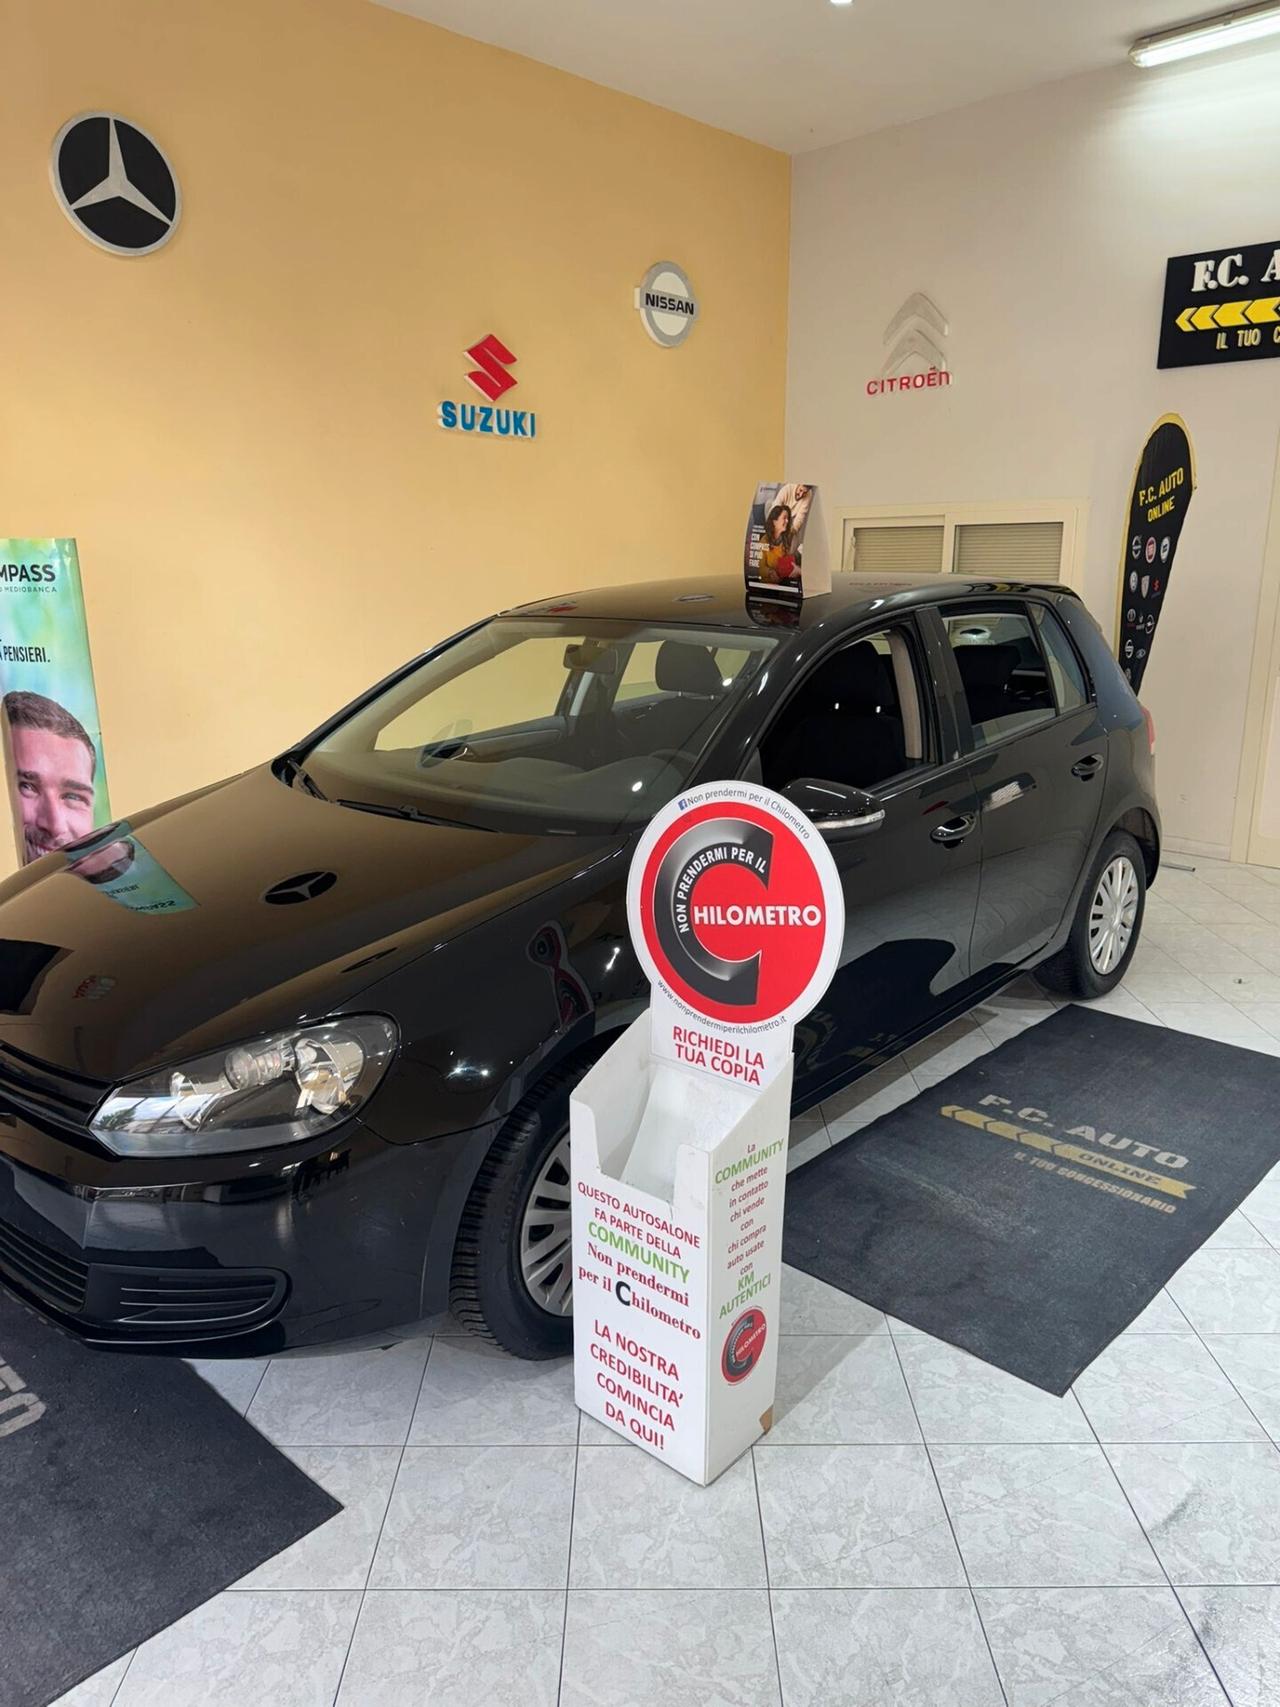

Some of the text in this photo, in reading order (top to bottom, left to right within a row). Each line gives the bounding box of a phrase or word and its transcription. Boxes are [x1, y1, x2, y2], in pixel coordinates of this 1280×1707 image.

[1191, 253, 1250, 292] F.C.
[645, 292, 695, 316] NISSAN
[1216, 332, 1229, 350] IL
[1237, 328, 1261, 347] TUO
[440, 400, 536, 438] SUZUKI
[1138, 467, 1185, 506] F.C. AUTO
[1147, 495, 1176, 522] ONLINE
[3, 646, 50, 662] PENSIERI.
[687, 795, 704, 806] Non
[705, 788, 747, 801] prendermi
[749, 792, 763, 803] per
[770, 801, 810, 840] Chilometro
[676, 847, 766, 933] NON PRENDERMI PER IL
[657, 980, 787, 1034] www.nonprendermiperilchilometro.it
[673, 1026, 764, 1069] RICHIEDI LA
[675, 1043, 760, 1086] TUA COPIA
[747, 1144, 756, 1154] La
[978, 1094, 1189, 1169] F.C. AUTO
[715, 1138, 784, 1185] COMMUNITY
[731, 1167, 768, 1192] che mette
[1078, 1153, 1162, 1185] ONLINE
[729, 1181, 769, 1208] in contatto
[1029, 1156, 1055, 1172] TUO
[1056, 1167, 1177, 1215] CONCESSIONARIO
[577, 1182, 700, 1248] QUESTO AUTOSALONE
[730, 1196, 765, 1222] chi vende
[740, 1218, 754, 1231] con
[588, 1221, 690, 1283] COMMUNITY
[594, 1207, 681, 1259] FA PARTE DELLA
[728, 1225, 767, 1254] chi compra
[587, 1241, 689, 1307] Non prendermi
[727, 1240, 765, 1270] auto usate
[740, 1262, 753, 1275] con
[719, 1272, 771, 1319] AUTENTICI
[737, 1270, 754, 1291] KM
[578, 1266, 701, 1340] per il Chilometro
[595, 1319, 679, 1381] LA NOSTRA
[597, 1372, 675, 1431] COMINCIA
[606, 1401, 664, 1450] DA QUI!
